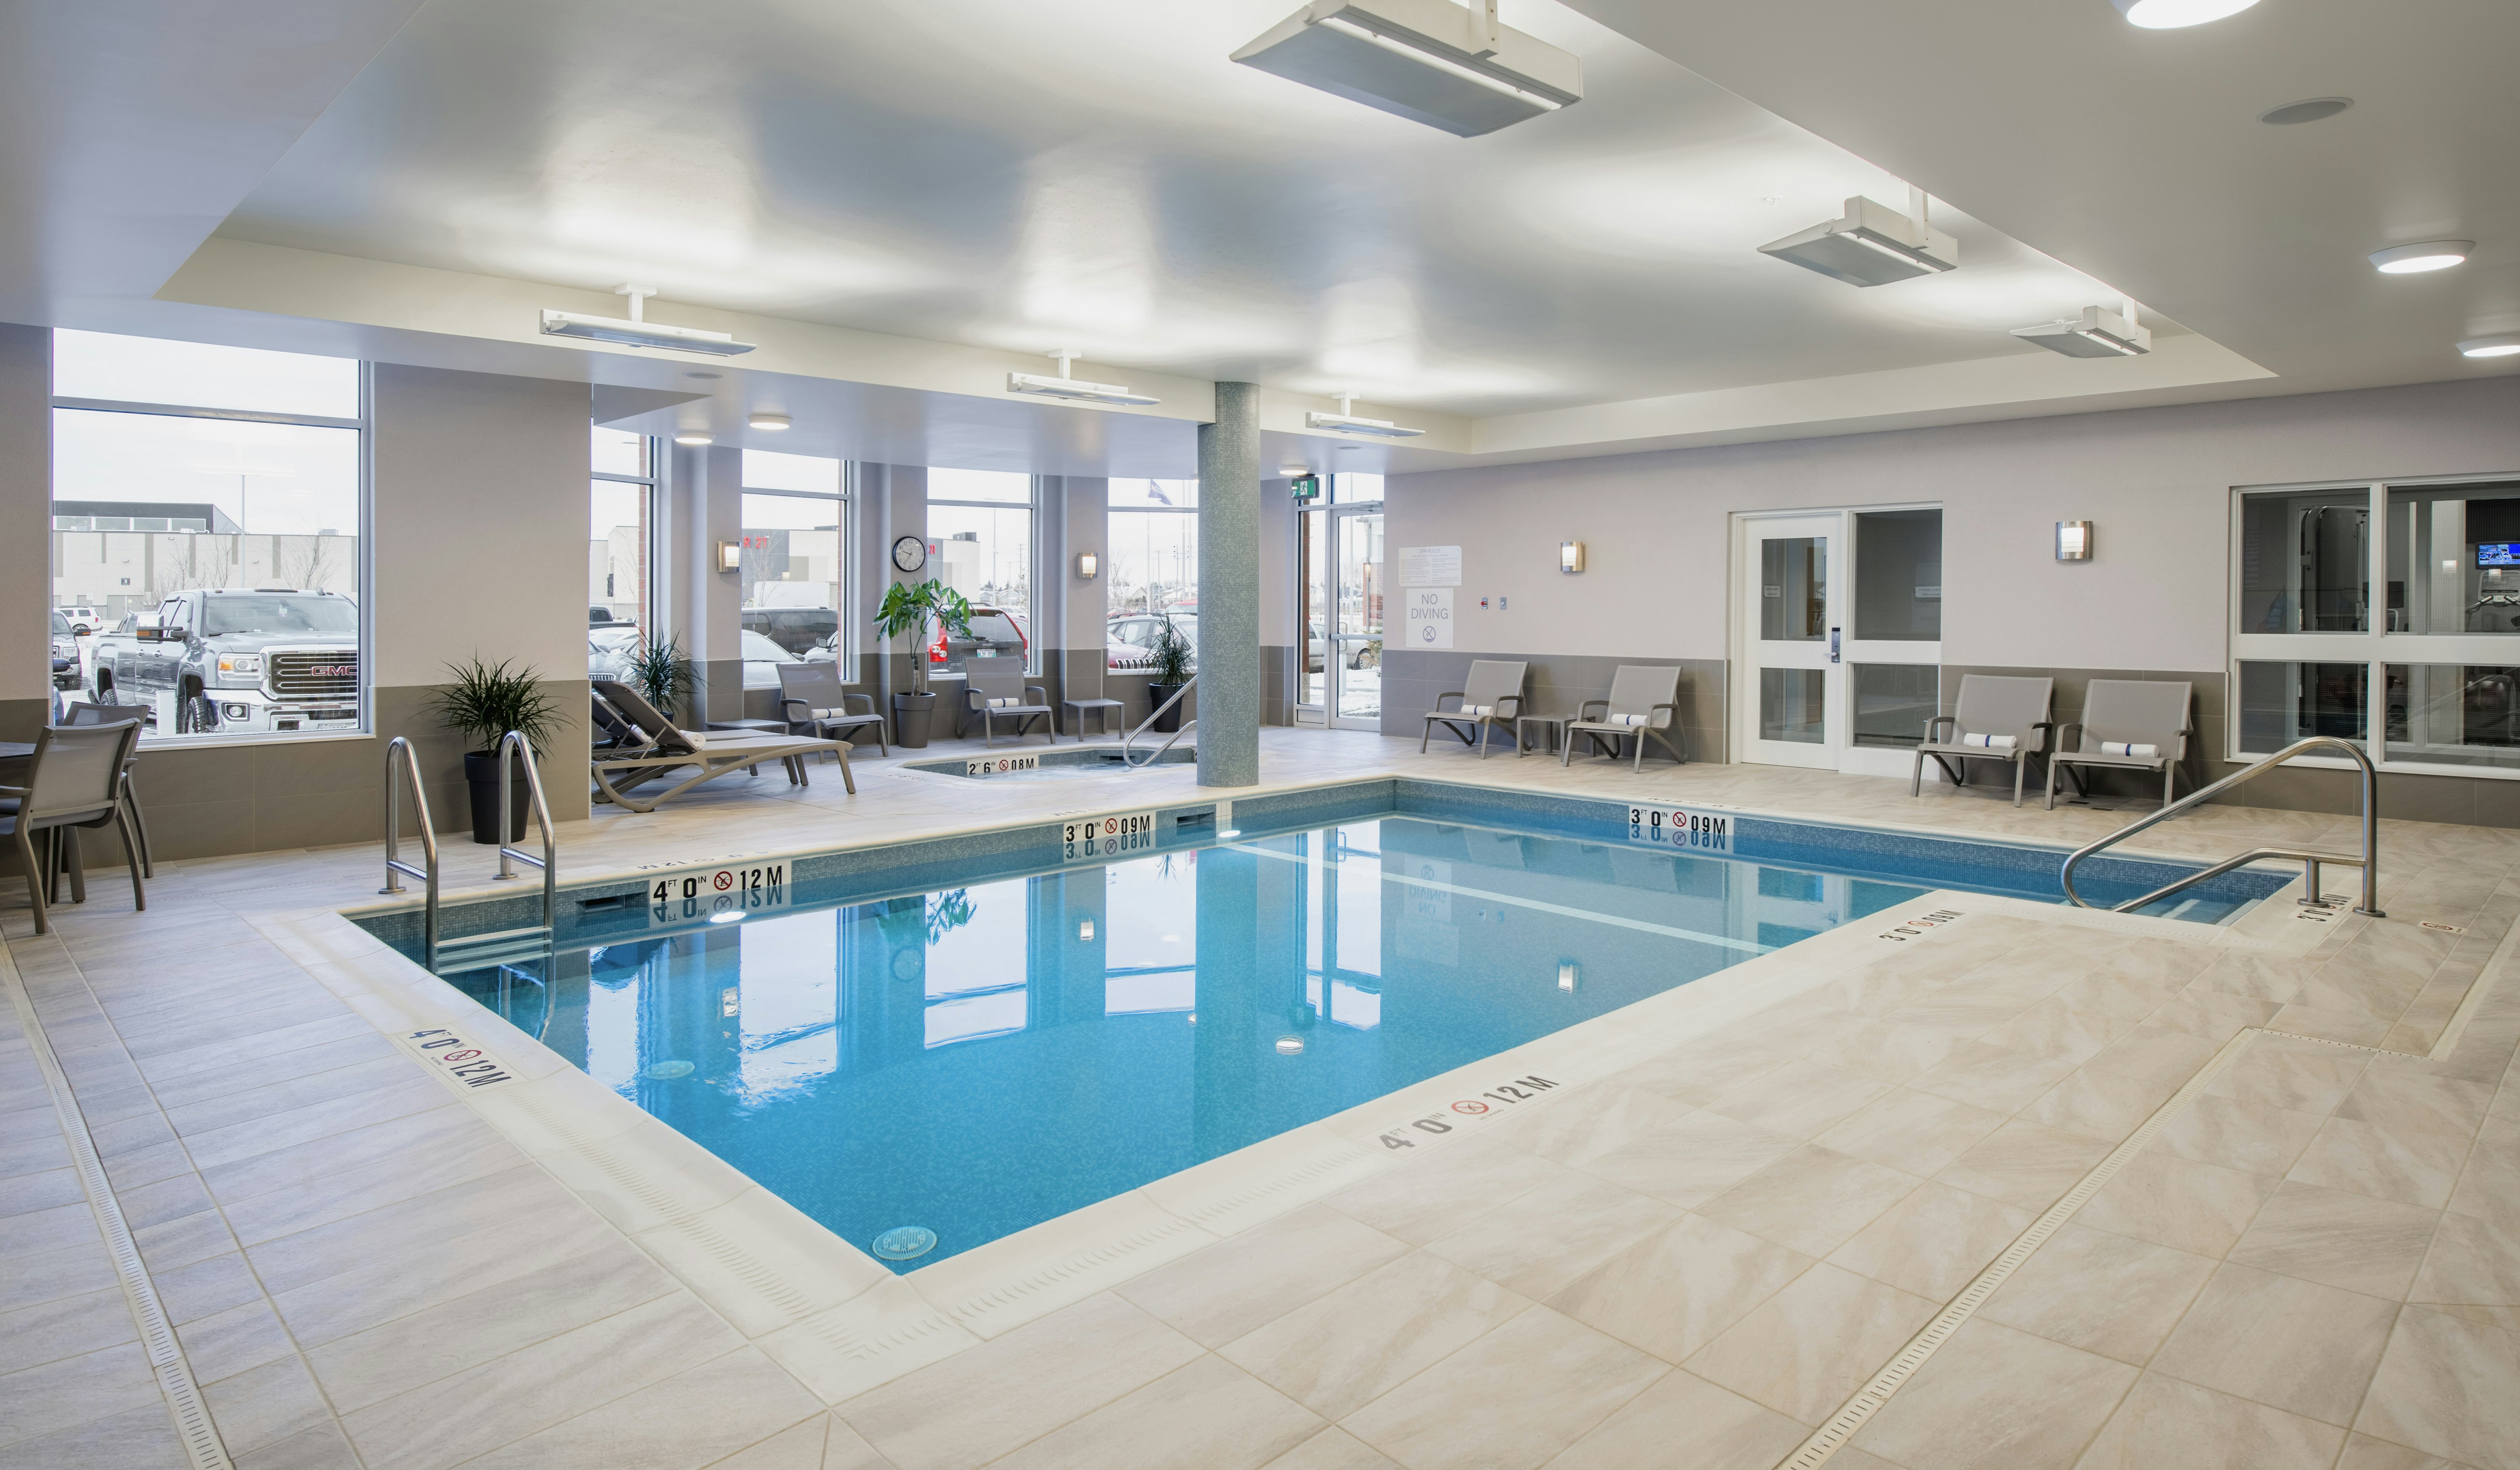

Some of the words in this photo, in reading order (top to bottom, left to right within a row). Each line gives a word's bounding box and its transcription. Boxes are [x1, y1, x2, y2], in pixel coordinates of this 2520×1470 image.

[756, 537, 767, 548] 21
[1421, 593, 1438, 605] NO
[1411, 608, 1448, 619] DIVING
[312, 665, 357, 676] GMC
[969, 763, 976, 775] 2
[984, 762, 990, 773] 6
[1631, 809, 1640, 824] 3
[1651, 811, 1661, 826] 0
[1066, 826, 1075, 842] 3
[1085, 823, 1094, 839] 0
[653, 881, 668, 902] 4
[683, 878, 697, 898] 0
[409, 1029, 446, 1039] 4
[421, 1038, 460, 1049] 0
[1379, 1135, 1416, 1150] 4
[1412, 1119, 1453, 1134] 0
